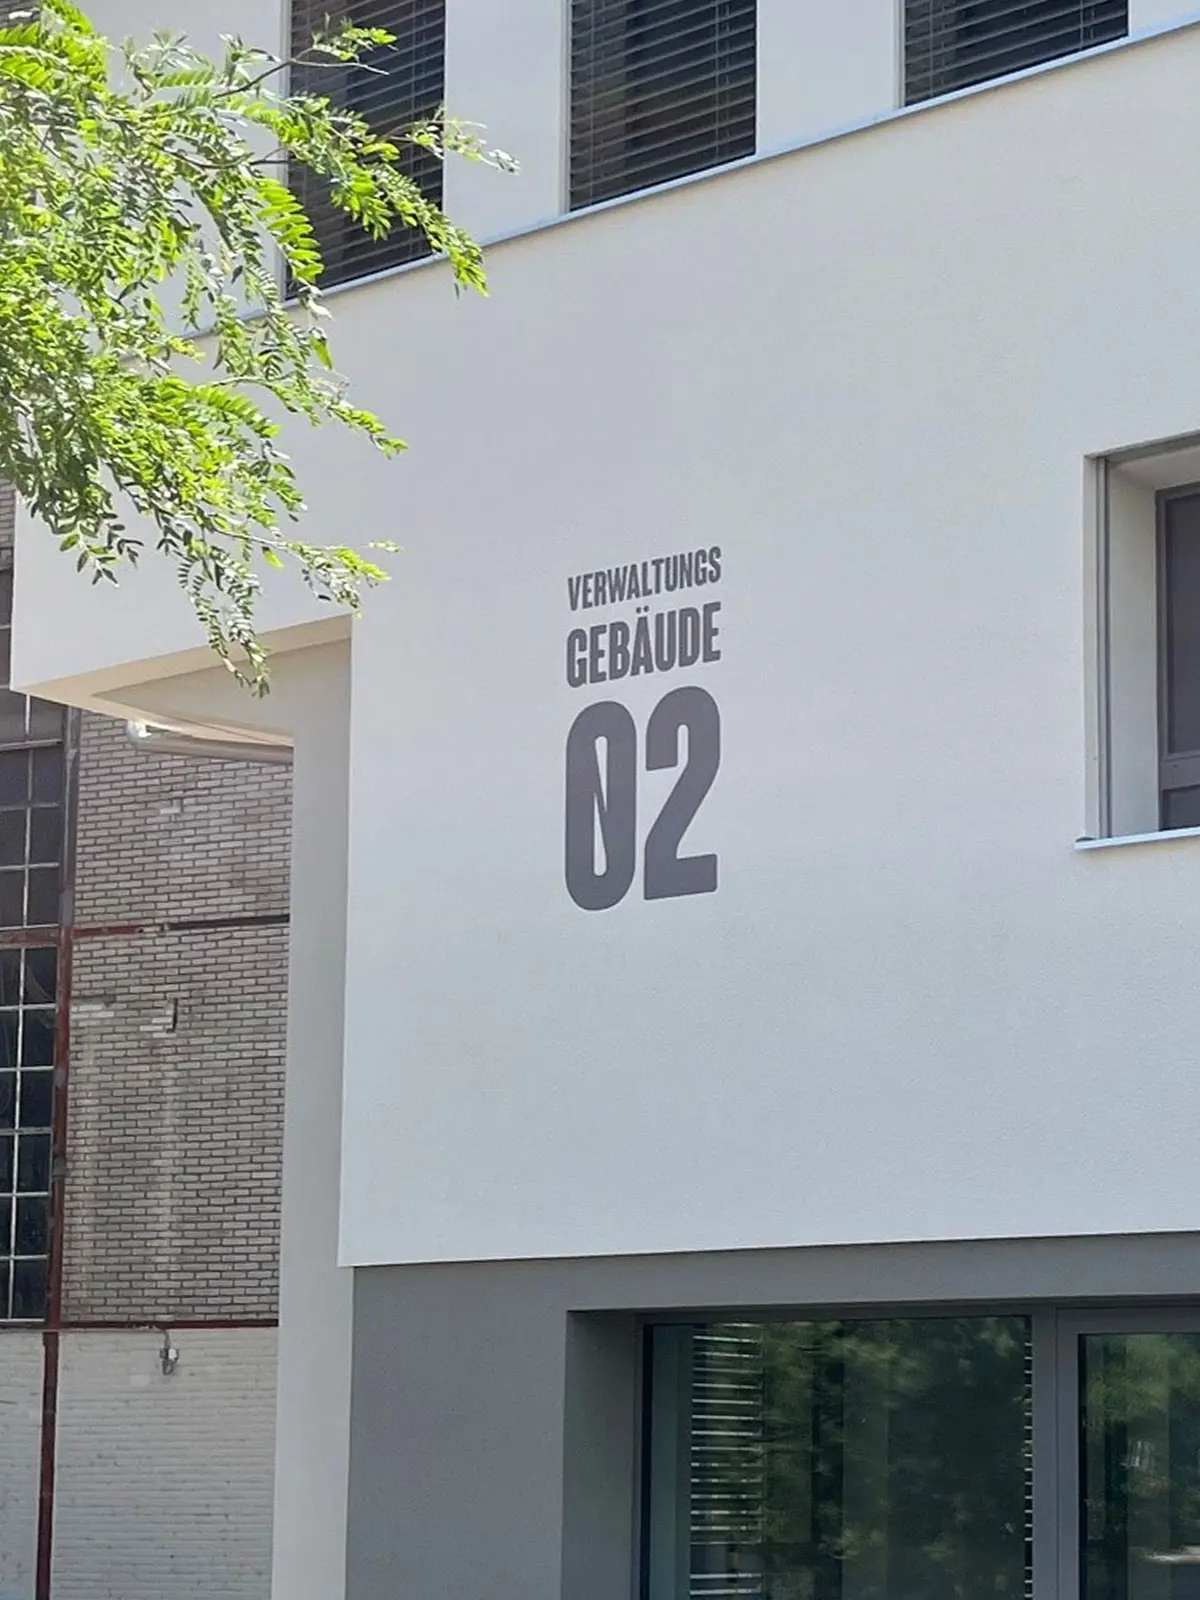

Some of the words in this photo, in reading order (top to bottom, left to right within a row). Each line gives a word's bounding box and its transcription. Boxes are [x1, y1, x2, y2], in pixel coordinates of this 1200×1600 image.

[567, 545, 722, 612] VERWALTUNGS
[566, 601, 722, 689] GEBÄUDE
[565, 685, 721, 912] 02
